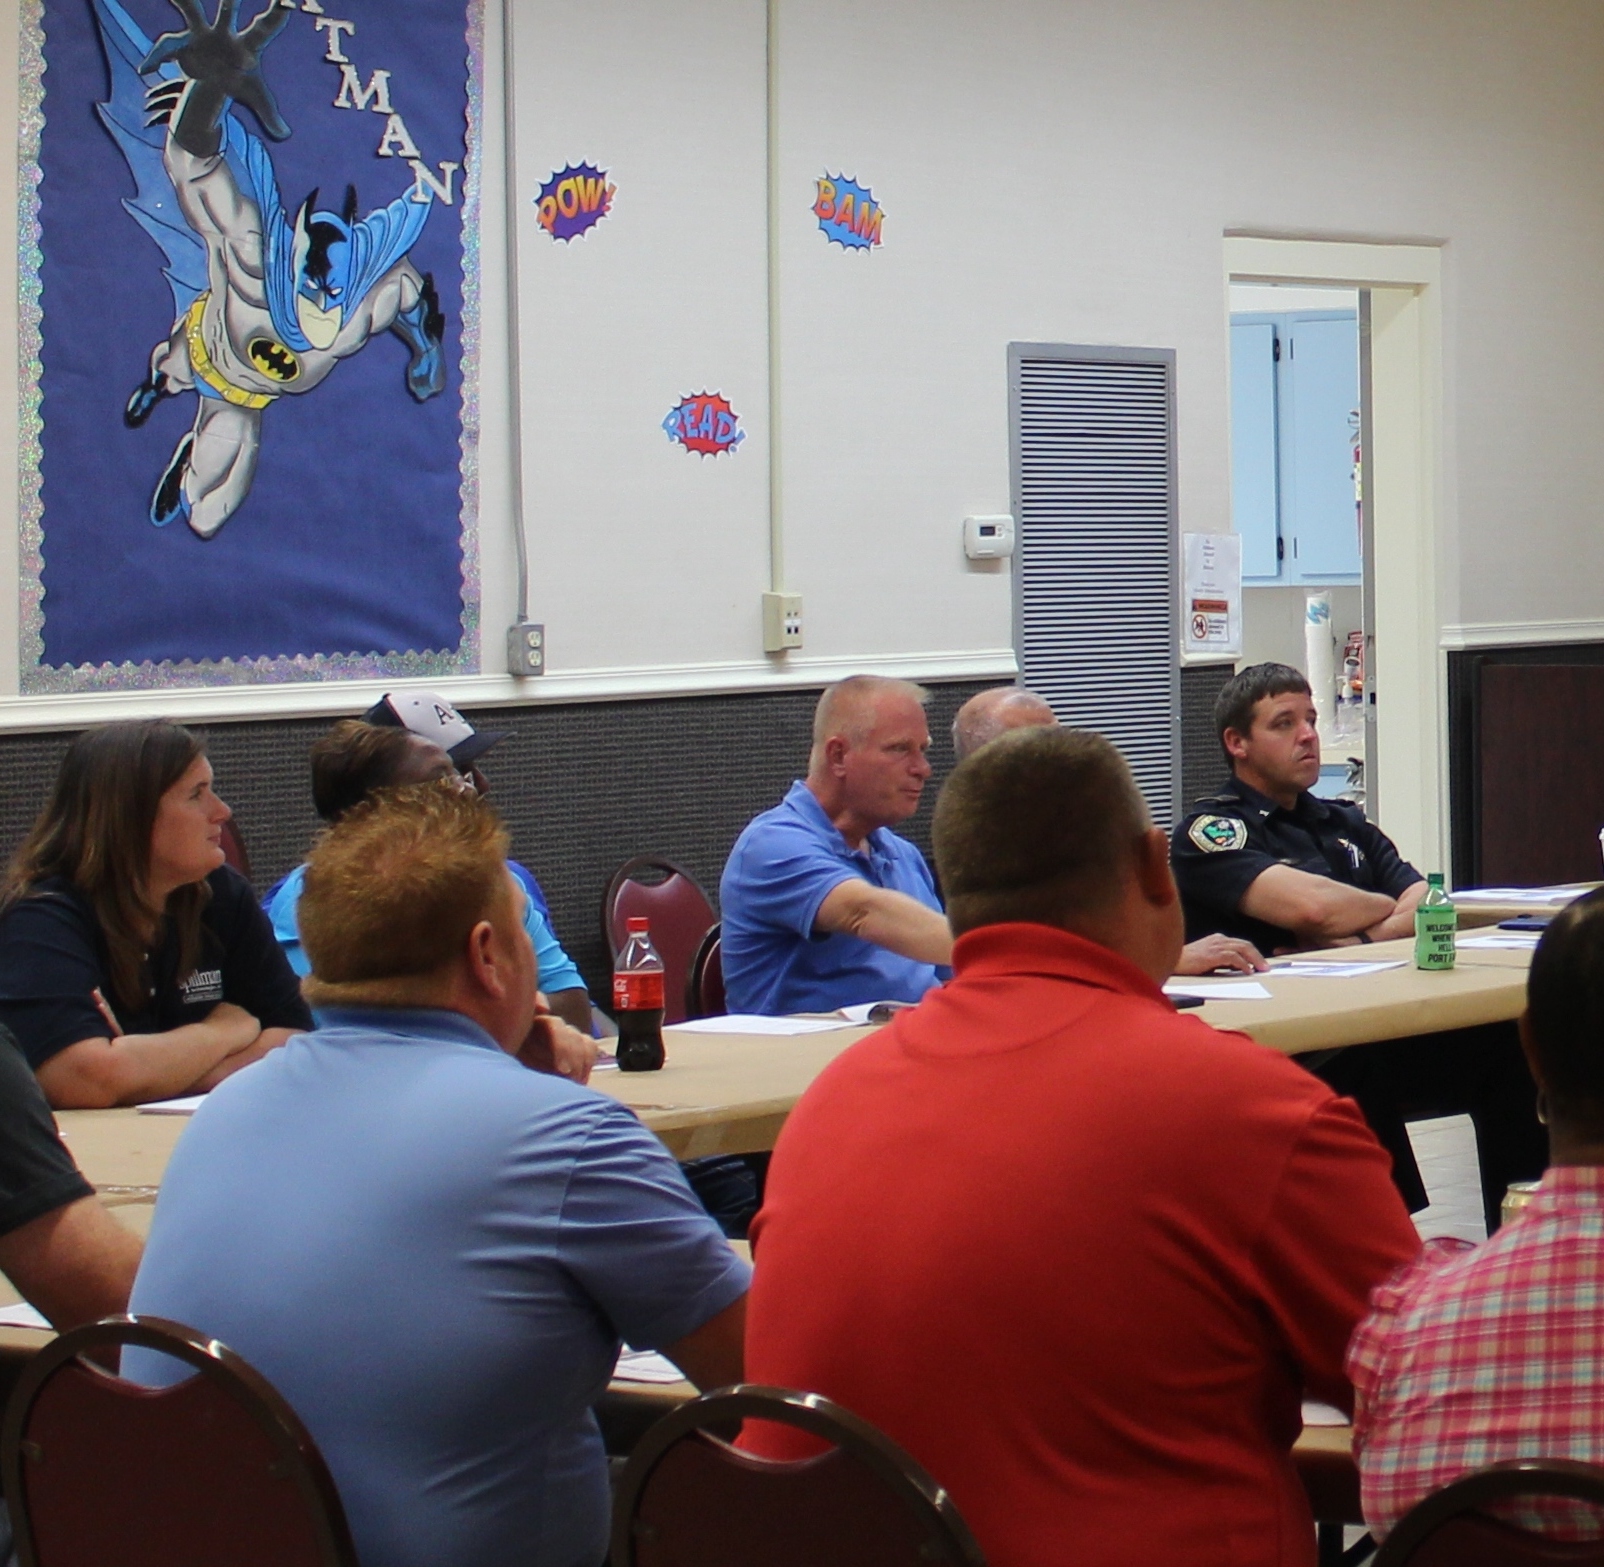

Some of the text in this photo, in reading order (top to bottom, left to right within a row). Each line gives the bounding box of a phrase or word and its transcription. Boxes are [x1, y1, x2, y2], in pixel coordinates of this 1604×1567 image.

[536, 174, 618, 234] POW!
[814, 178, 885, 246] BAM
[661, 402, 747, 453] READ!
[1427, 953, 1448, 963] PORT
